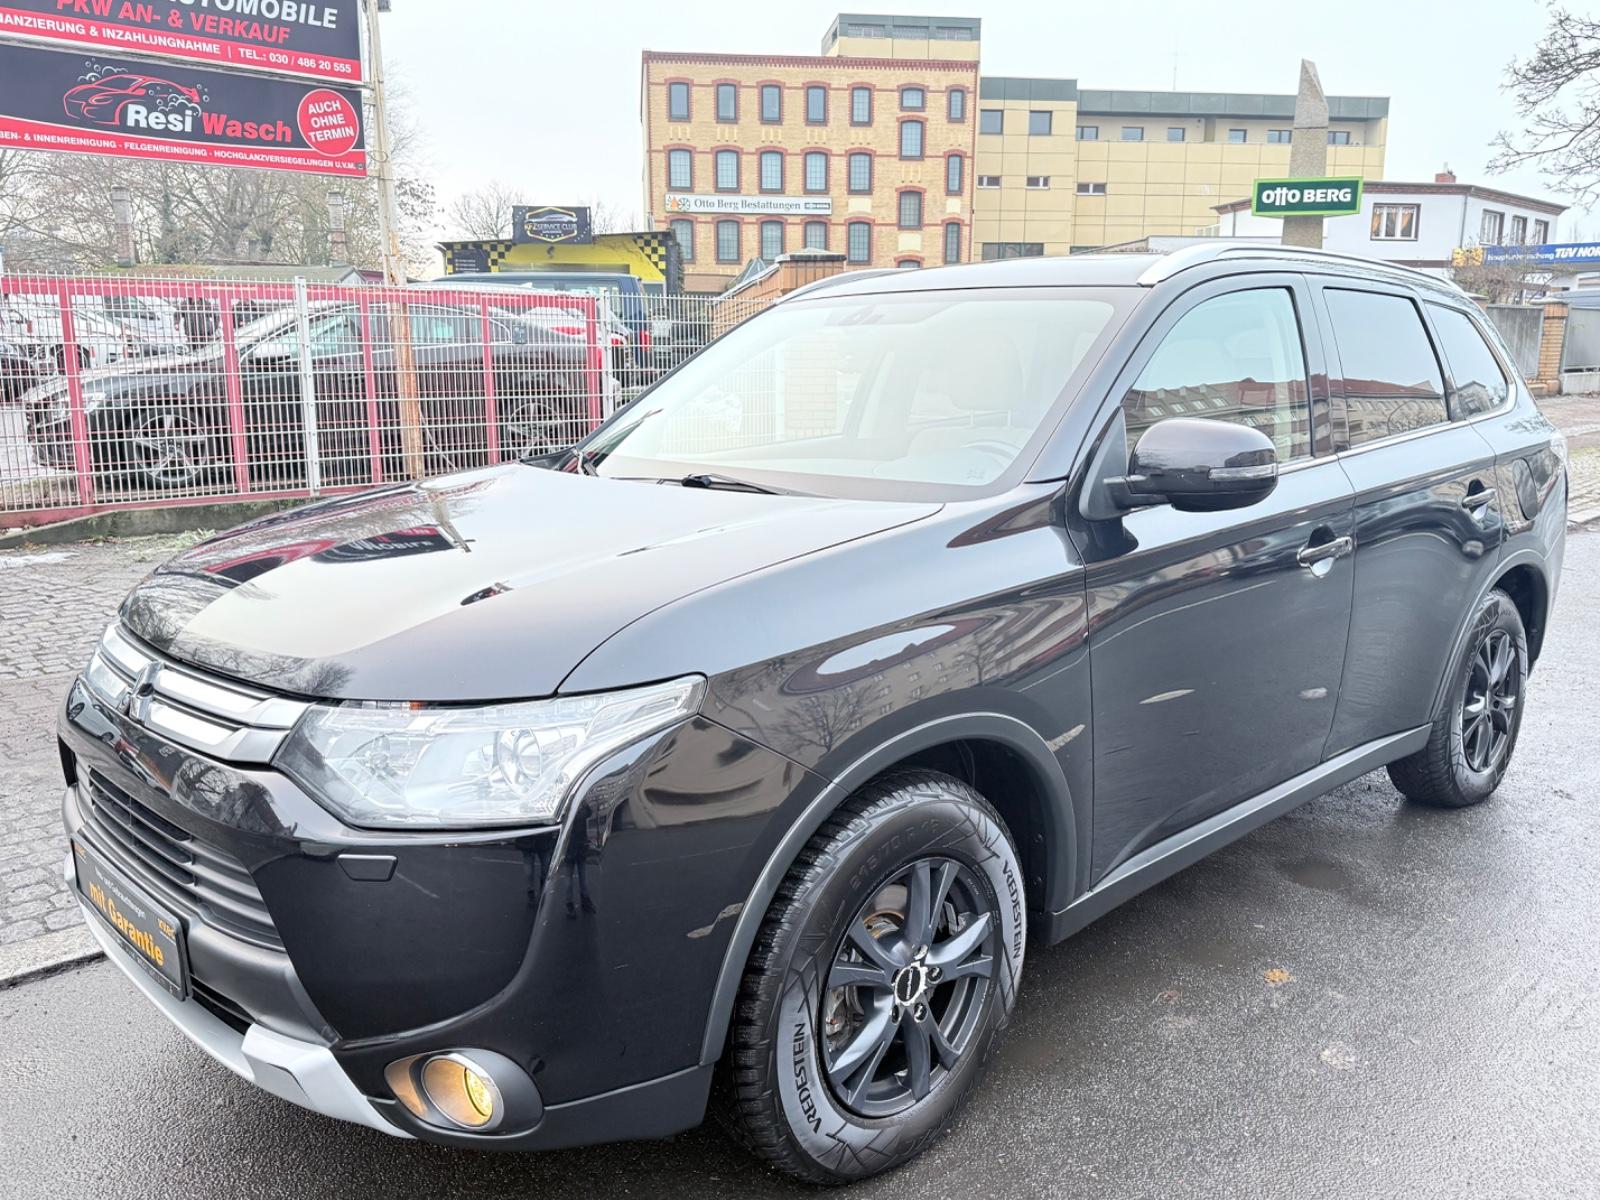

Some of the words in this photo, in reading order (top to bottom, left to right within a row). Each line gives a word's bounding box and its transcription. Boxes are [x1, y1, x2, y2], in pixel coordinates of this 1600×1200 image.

[118, 1, 160, 23] AN-
[168, 9, 183, 28] &
[190, 12, 290, 44] VERKAUF
[168, 0, 338, 28] OMOBILE
[90, 27, 98, 37] &
[102, 28, 220, 54] INZAHLUNGNAHME
[269, 54, 288, 64] 030
[297, 57, 316, 68] 486
[319, 60, 331, 70] 20
[334, 63, 351, 73] 555
[308, 100, 341, 114] AUCH
[311, 113, 345, 128] OHNE
[127, 104, 192, 132] Resi
[202, 112, 292, 142] Wasch
[308, 126, 354, 142] TERMIN
[34, 134, 116, 148] INNENREINIGUNG
[124, 142, 207, 156] FELGENREINIGUNG
[694, 199, 715, 208] Otto
[717, 199, 739, 210] Berg
[741, 199, 801, 211] Bestattungen
[1302, 188, 1352, 203] BERG
[1003, 859, 1022, 959] VREDESTEIN
[90, 882, 107, 913] mit
[108, 897, 164, 967] Garantie
[792, 1022, 822, 1134] VREDESTEIN
